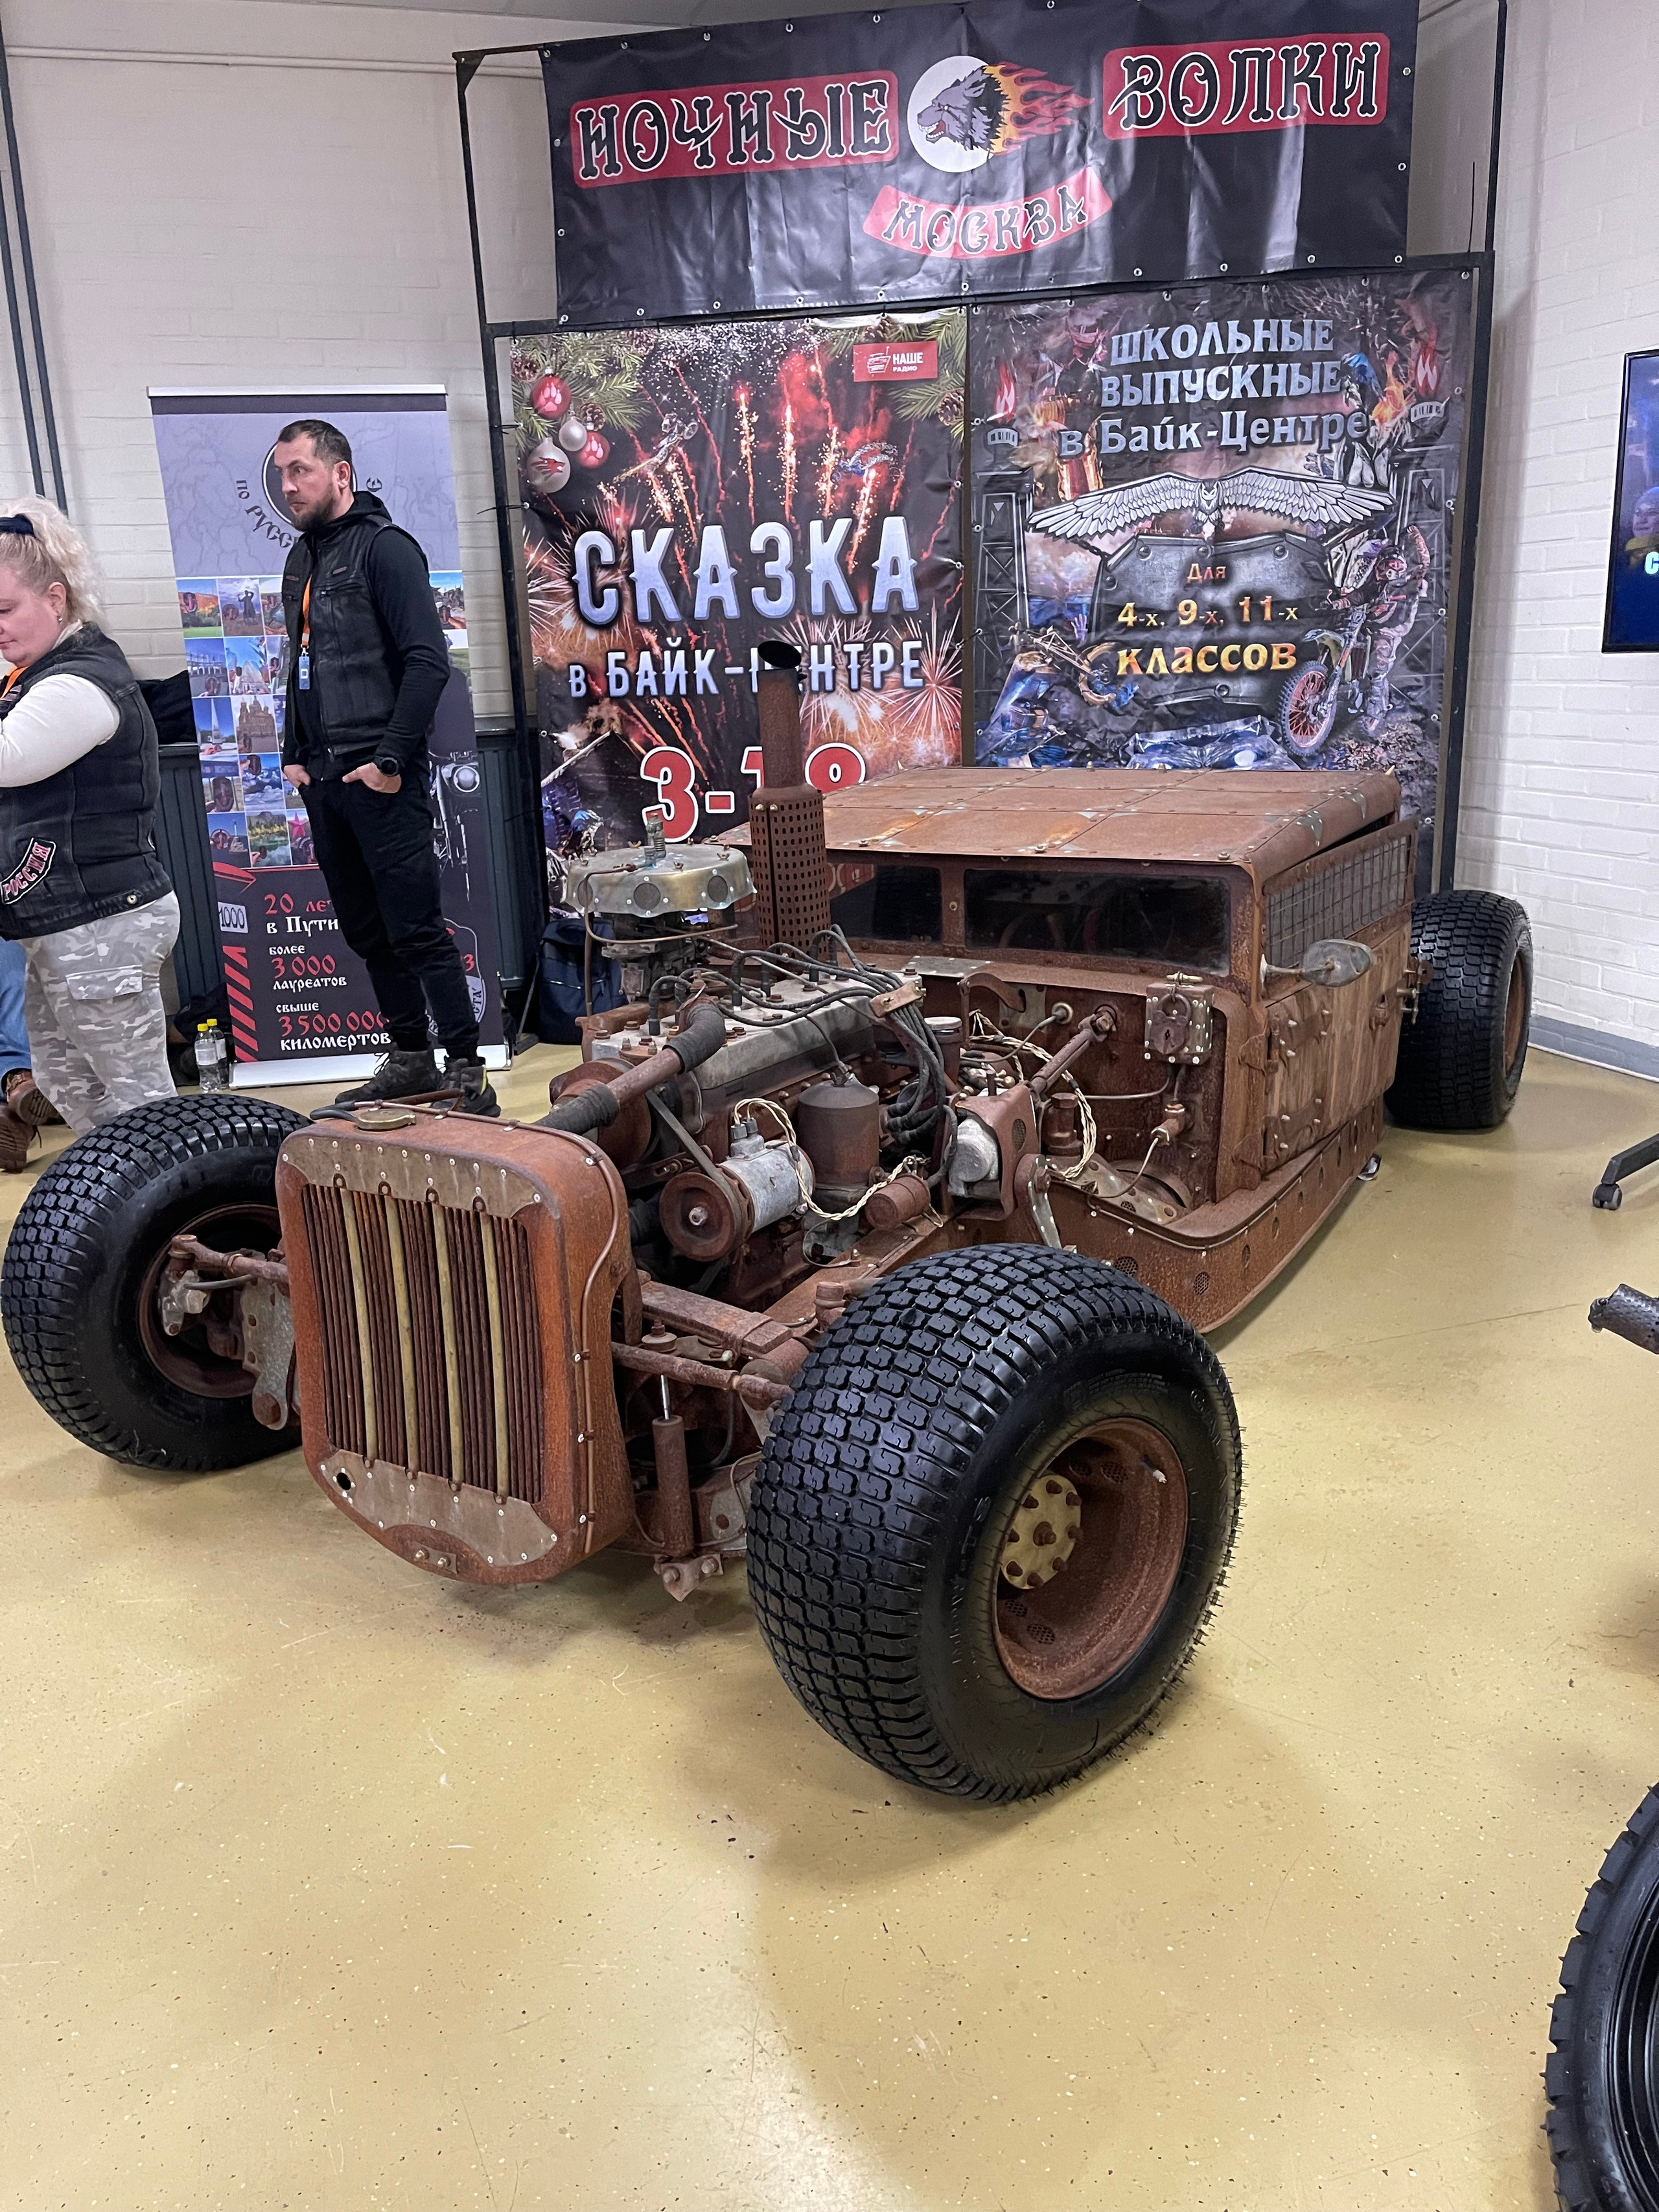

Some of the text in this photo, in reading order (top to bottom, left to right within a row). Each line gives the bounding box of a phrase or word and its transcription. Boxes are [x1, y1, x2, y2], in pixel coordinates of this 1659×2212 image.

[574, 41, 1380, 181] НОЧНЫЕ ВОЛКИ
[881, 185, 1089, 254] МОСКВА
[892, 352, 923, 365] НАШЕ
[1110, 319, 1334, 366] ШКОЛЬНЫЕ
[1100, 360, 1342, 408] ВЫПУСКНЫЕ
[1059, 410, 1369, 456] в Байк-Центре
[572, 517, 920, 625] СКАЗКА
[1187, 563, 1227, 583] Для
[1238, 596, 1299, 623] 11-х
[606, 637, 925, 697] БАЙК-НТРЕ
[3, 842, 51, 902] РОССИЯ
[218, 906, 246, 929] 1000
[263, 893, 332, 914] 20 ле
[266, 916, 339, 937] в Пути
[273, 976, 347, 993] лауреатов
[275, 1002, 319, 1014] свыше
